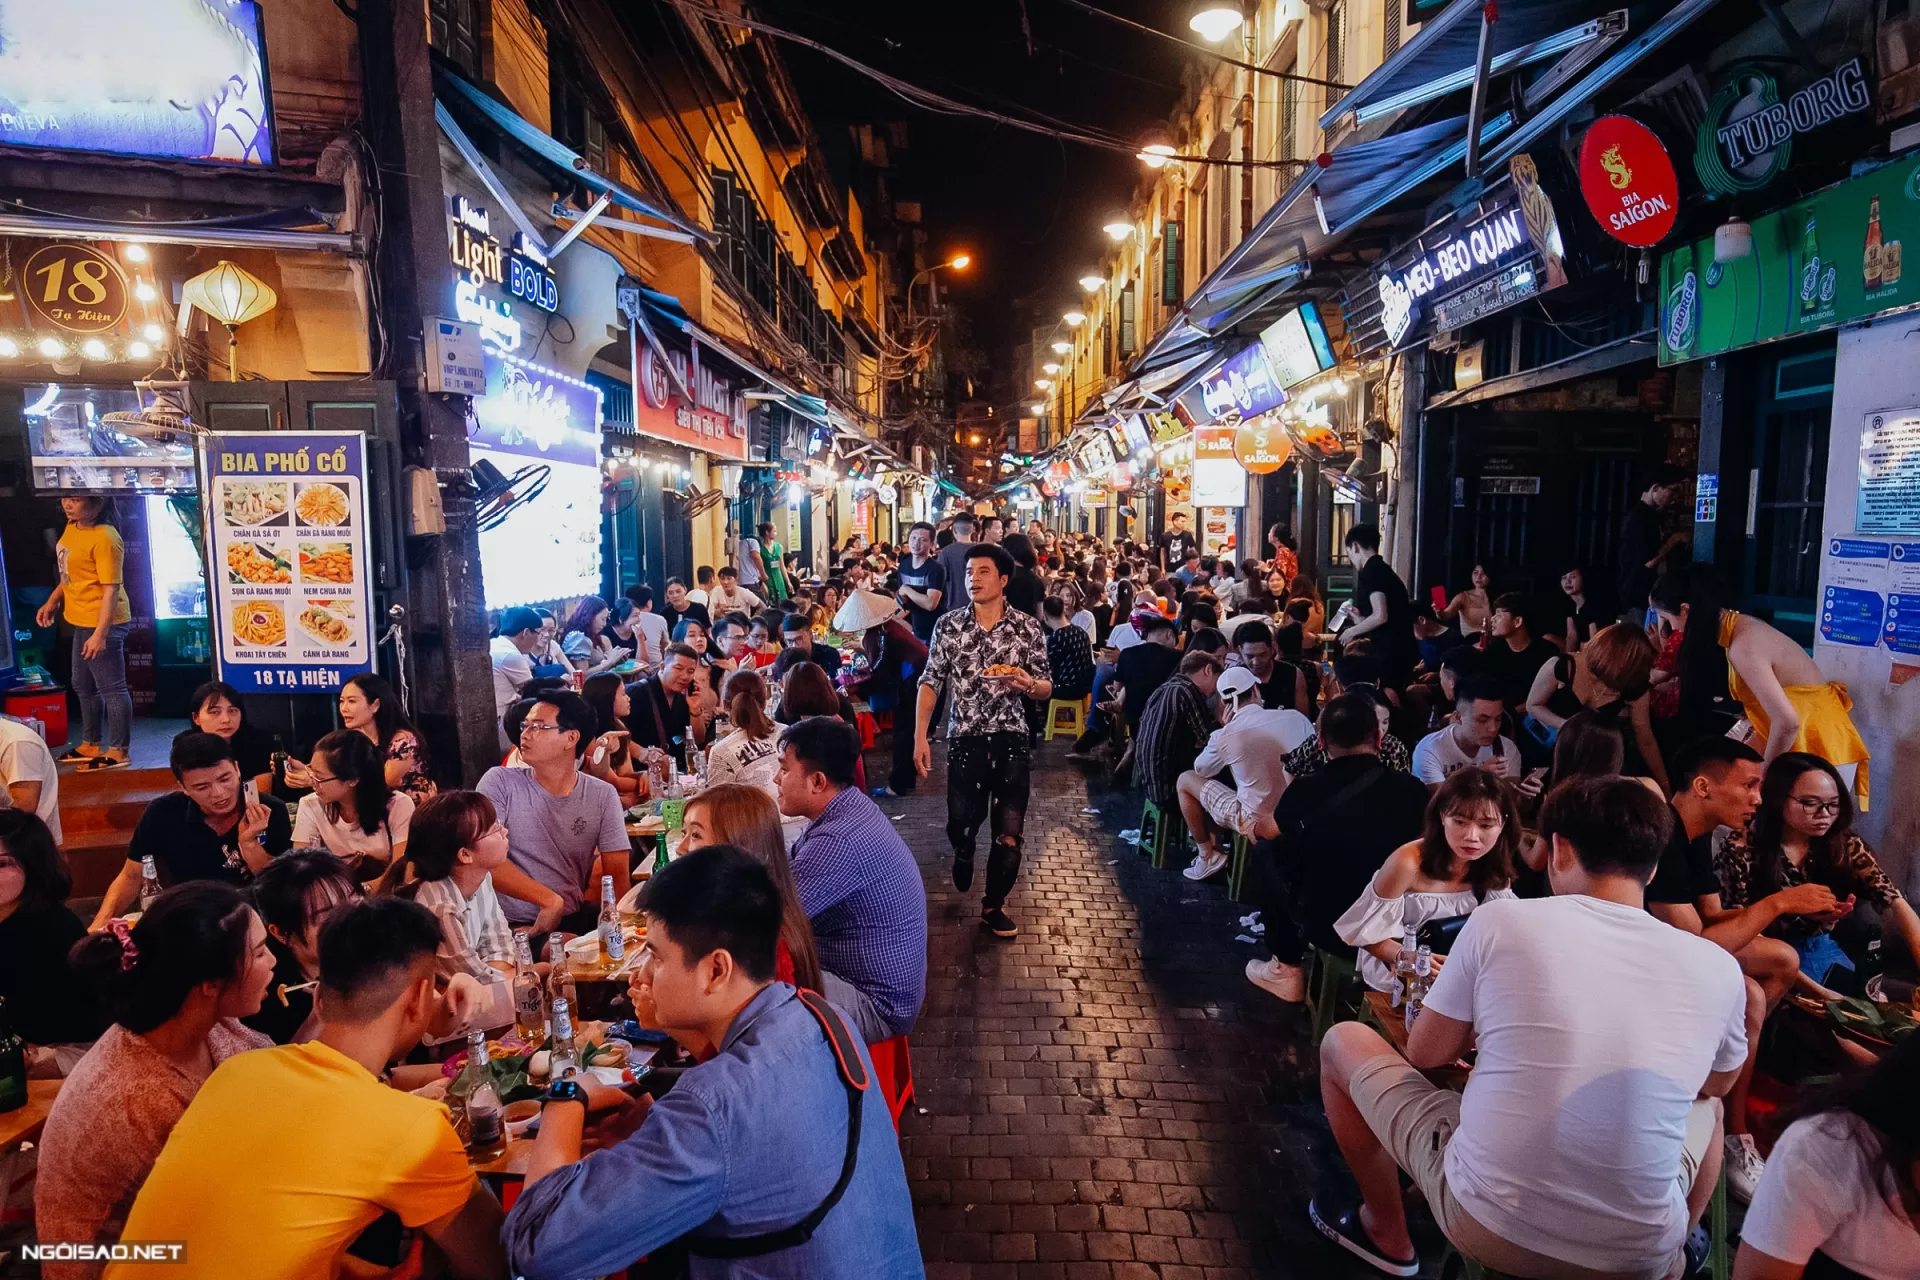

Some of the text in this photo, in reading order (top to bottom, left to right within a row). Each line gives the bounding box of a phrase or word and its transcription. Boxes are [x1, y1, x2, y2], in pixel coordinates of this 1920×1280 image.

[1717, 58, 1870, 169] TUBORG
[1621, 192, 1641, 206] BIA
[1609, 195, 1668, 231] SAIGON
[453, 227, 503, 288] Light
[36, 257, 108, 305] 18
[511, 256, 558, 312] BOLD
[1516, 282, 1535, 298] MORE
[1669, 289, 1693, 346] TUBORG
[1810, 309, 1835, 321] TUBORG
[221, 445, 347, 472] BIA PHỐ CỔ
[1244, 454, 1280, 463] SAIGON
[321, 529, 336, 537] RANG
[253, 667, 340, 688] 18 TẠ HIỆN
